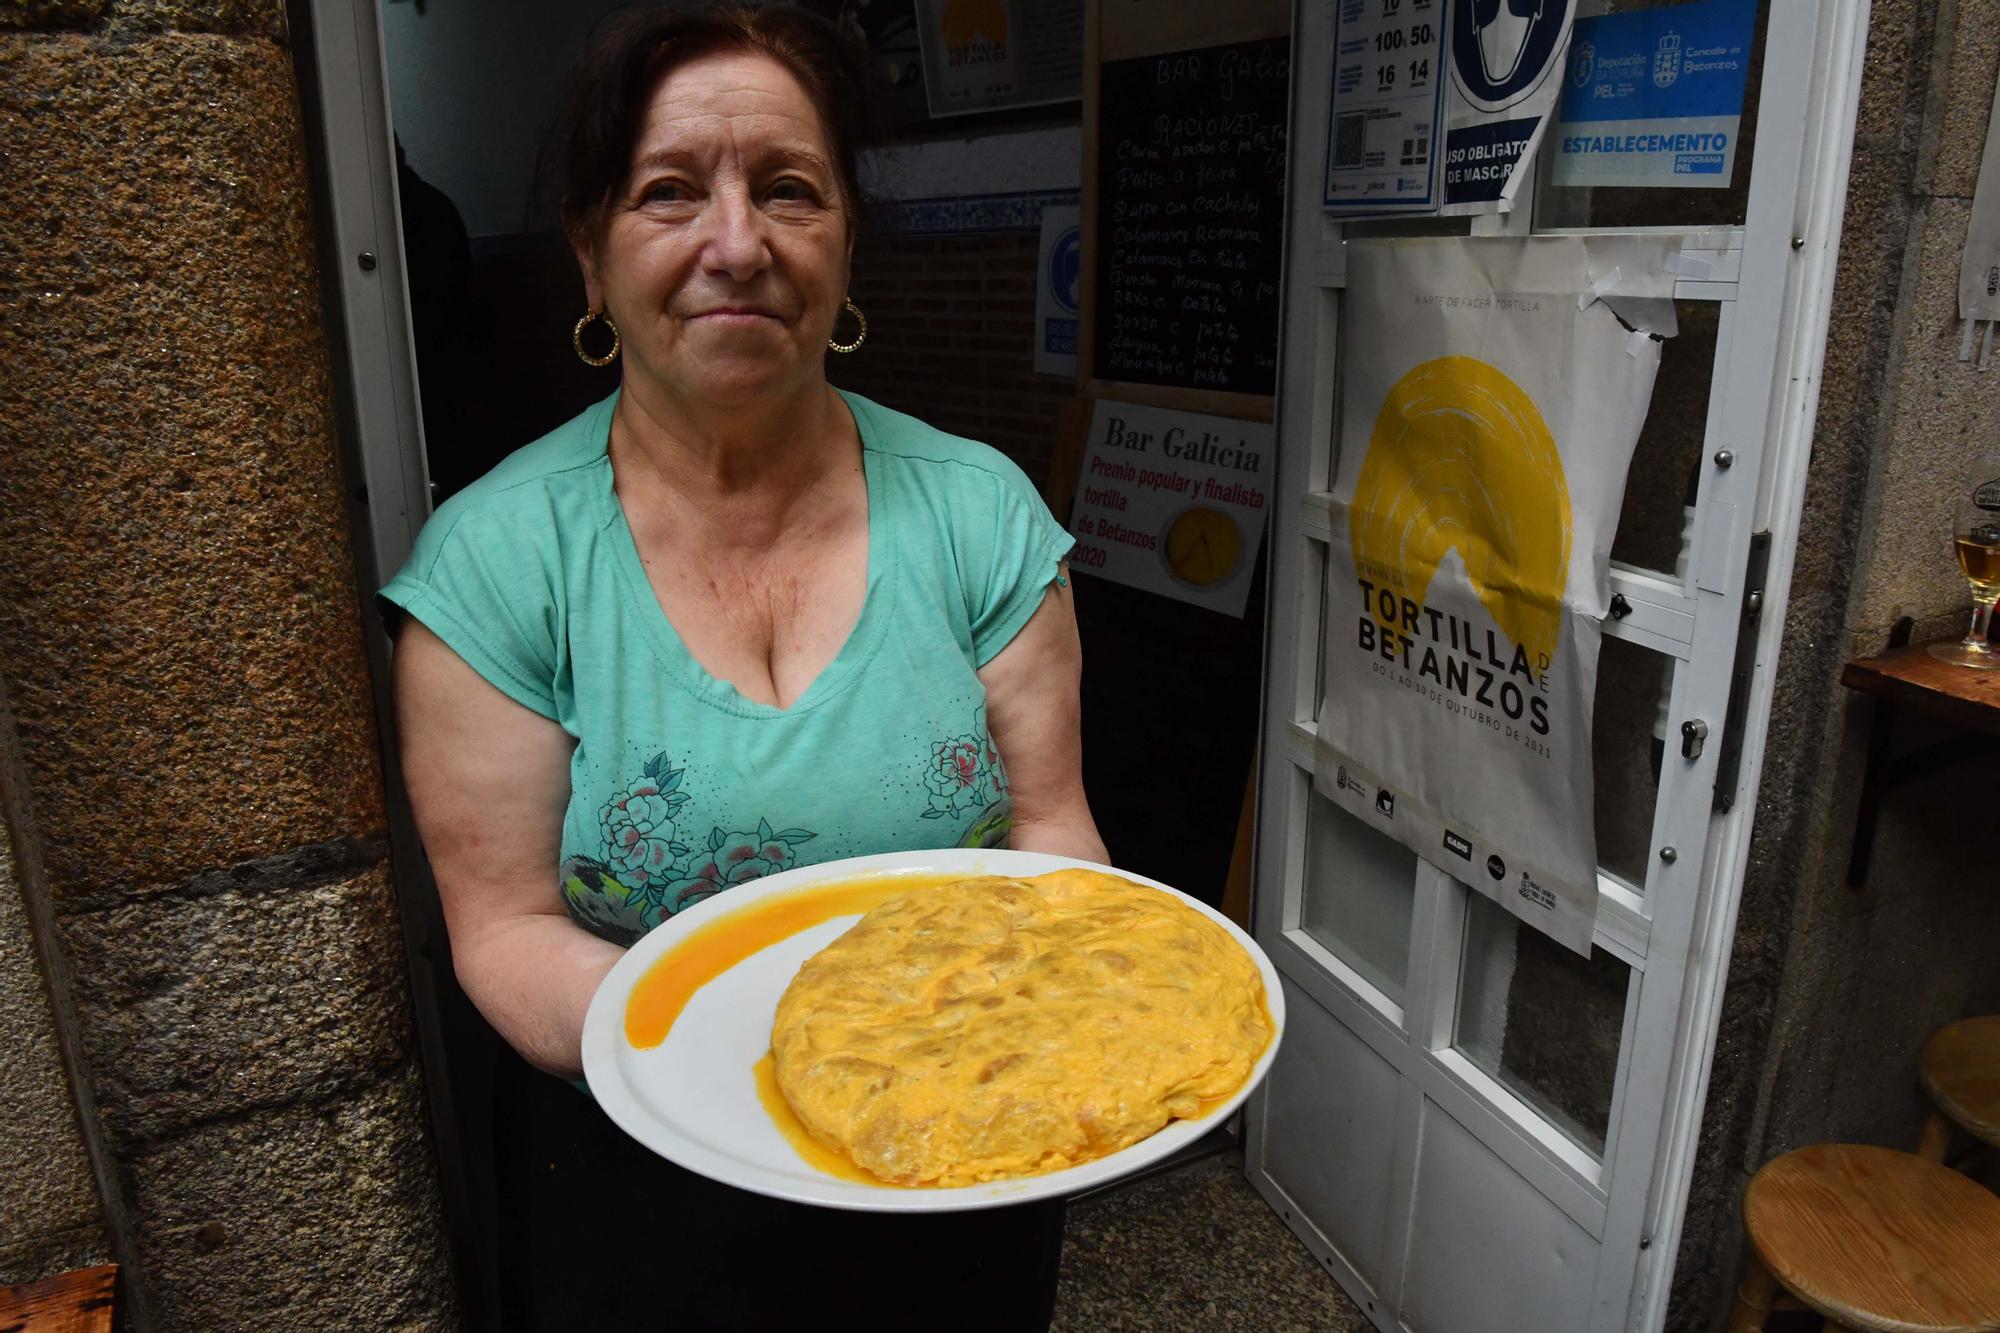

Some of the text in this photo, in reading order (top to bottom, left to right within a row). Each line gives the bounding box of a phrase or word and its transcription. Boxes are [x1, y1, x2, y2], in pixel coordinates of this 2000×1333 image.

[1156, 55, 1201, 87] BAR
[1377, 64, 1395, 85] 16
[1409, 59, 1428, 80] 14
[1562, 133, 1728, 154] ESTABLECEMENTO
[1448, 170, 1462, 184] DE
[1103, 417, 1260, 473] Bar Galicia
[1084, 485, 1128, 512] tortilla
[1090, 455, 1265, 509] Premio popular y finalista
[1078, 514, 1158, 551] de Betanzos
[1072, 543, 1106, 569] 2020
[1358, 578, 1535, 686] TORTILLA
[1358, 616, 1550, 736] BETANZOS
[1372, 662, 1387, 677] DO
[1400, 675, 1412, 689] AO
[1430, 690, 1443, 705] DE
[1447, 698, 1500, 731] OUTUBRO
[1506, 725, 1520, 742] DE
[1525, 736, 1551, 759] 2021
